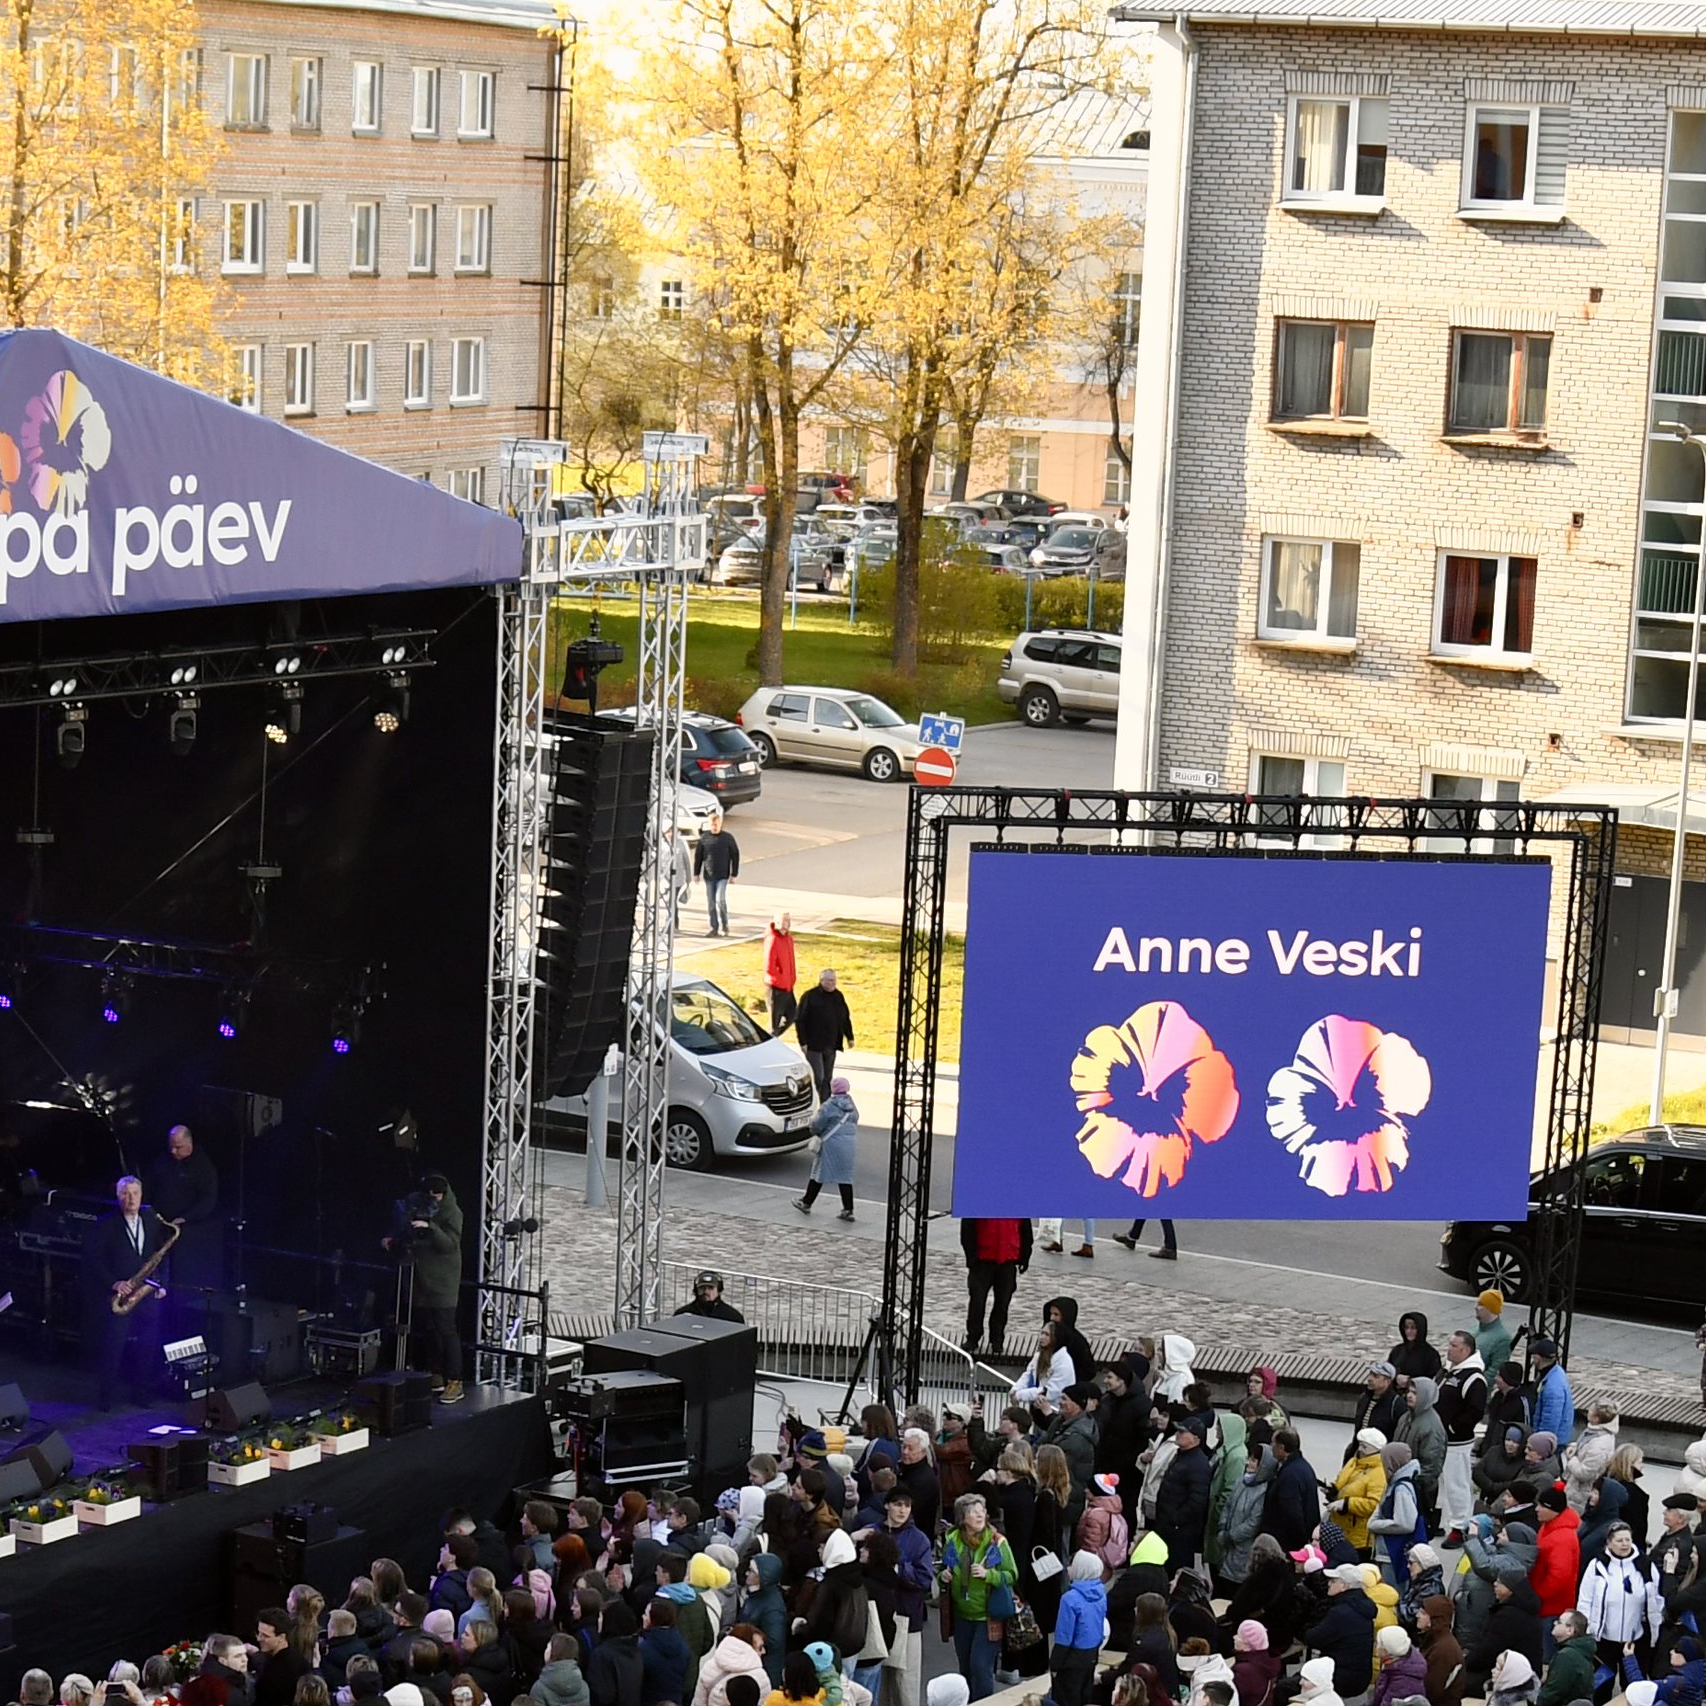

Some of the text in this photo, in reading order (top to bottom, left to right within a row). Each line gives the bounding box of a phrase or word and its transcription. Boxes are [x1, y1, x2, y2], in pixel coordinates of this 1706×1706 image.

[112, 476, 292, 596] päev
[1207, 774, 1214, 785] 2
[1093, 926, 1422, 978] Anne Veski
